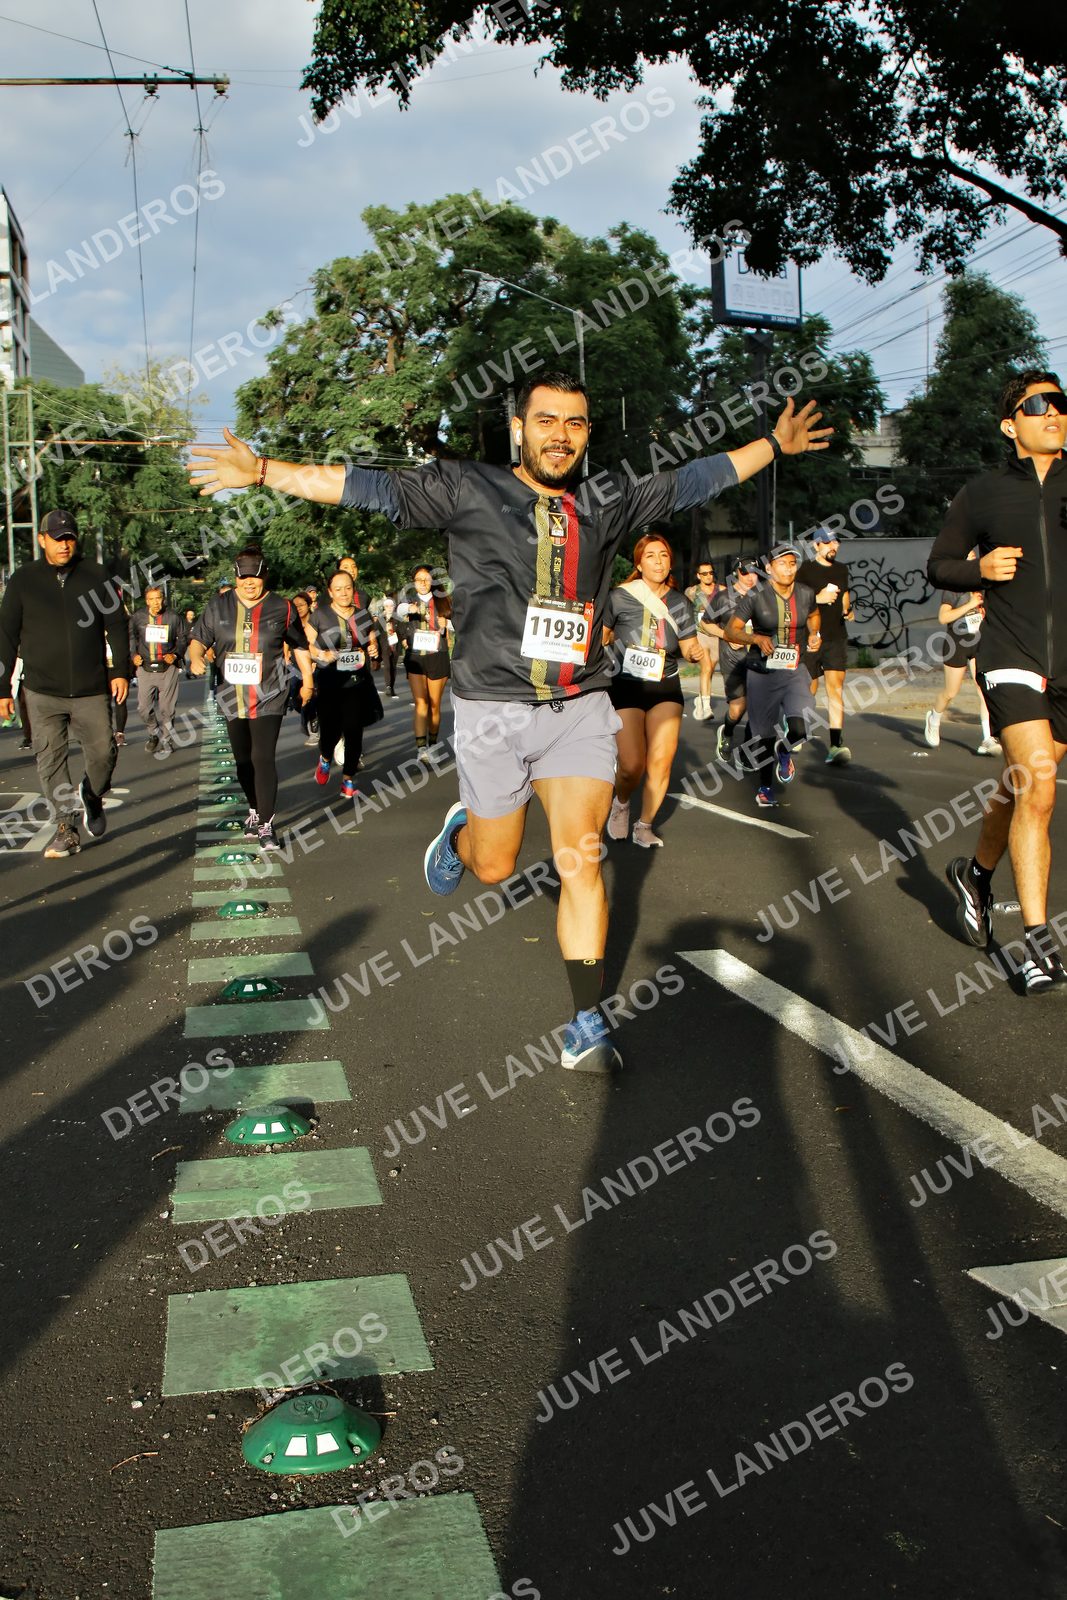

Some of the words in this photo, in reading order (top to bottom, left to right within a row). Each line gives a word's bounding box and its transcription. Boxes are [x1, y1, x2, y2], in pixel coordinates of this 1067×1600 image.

[530, 615, 585, 642] 11939
[340, 654, 360, 664] 4634
[629, 653, 657, 668] 4080
[226, 662, 257, 674] 10296
